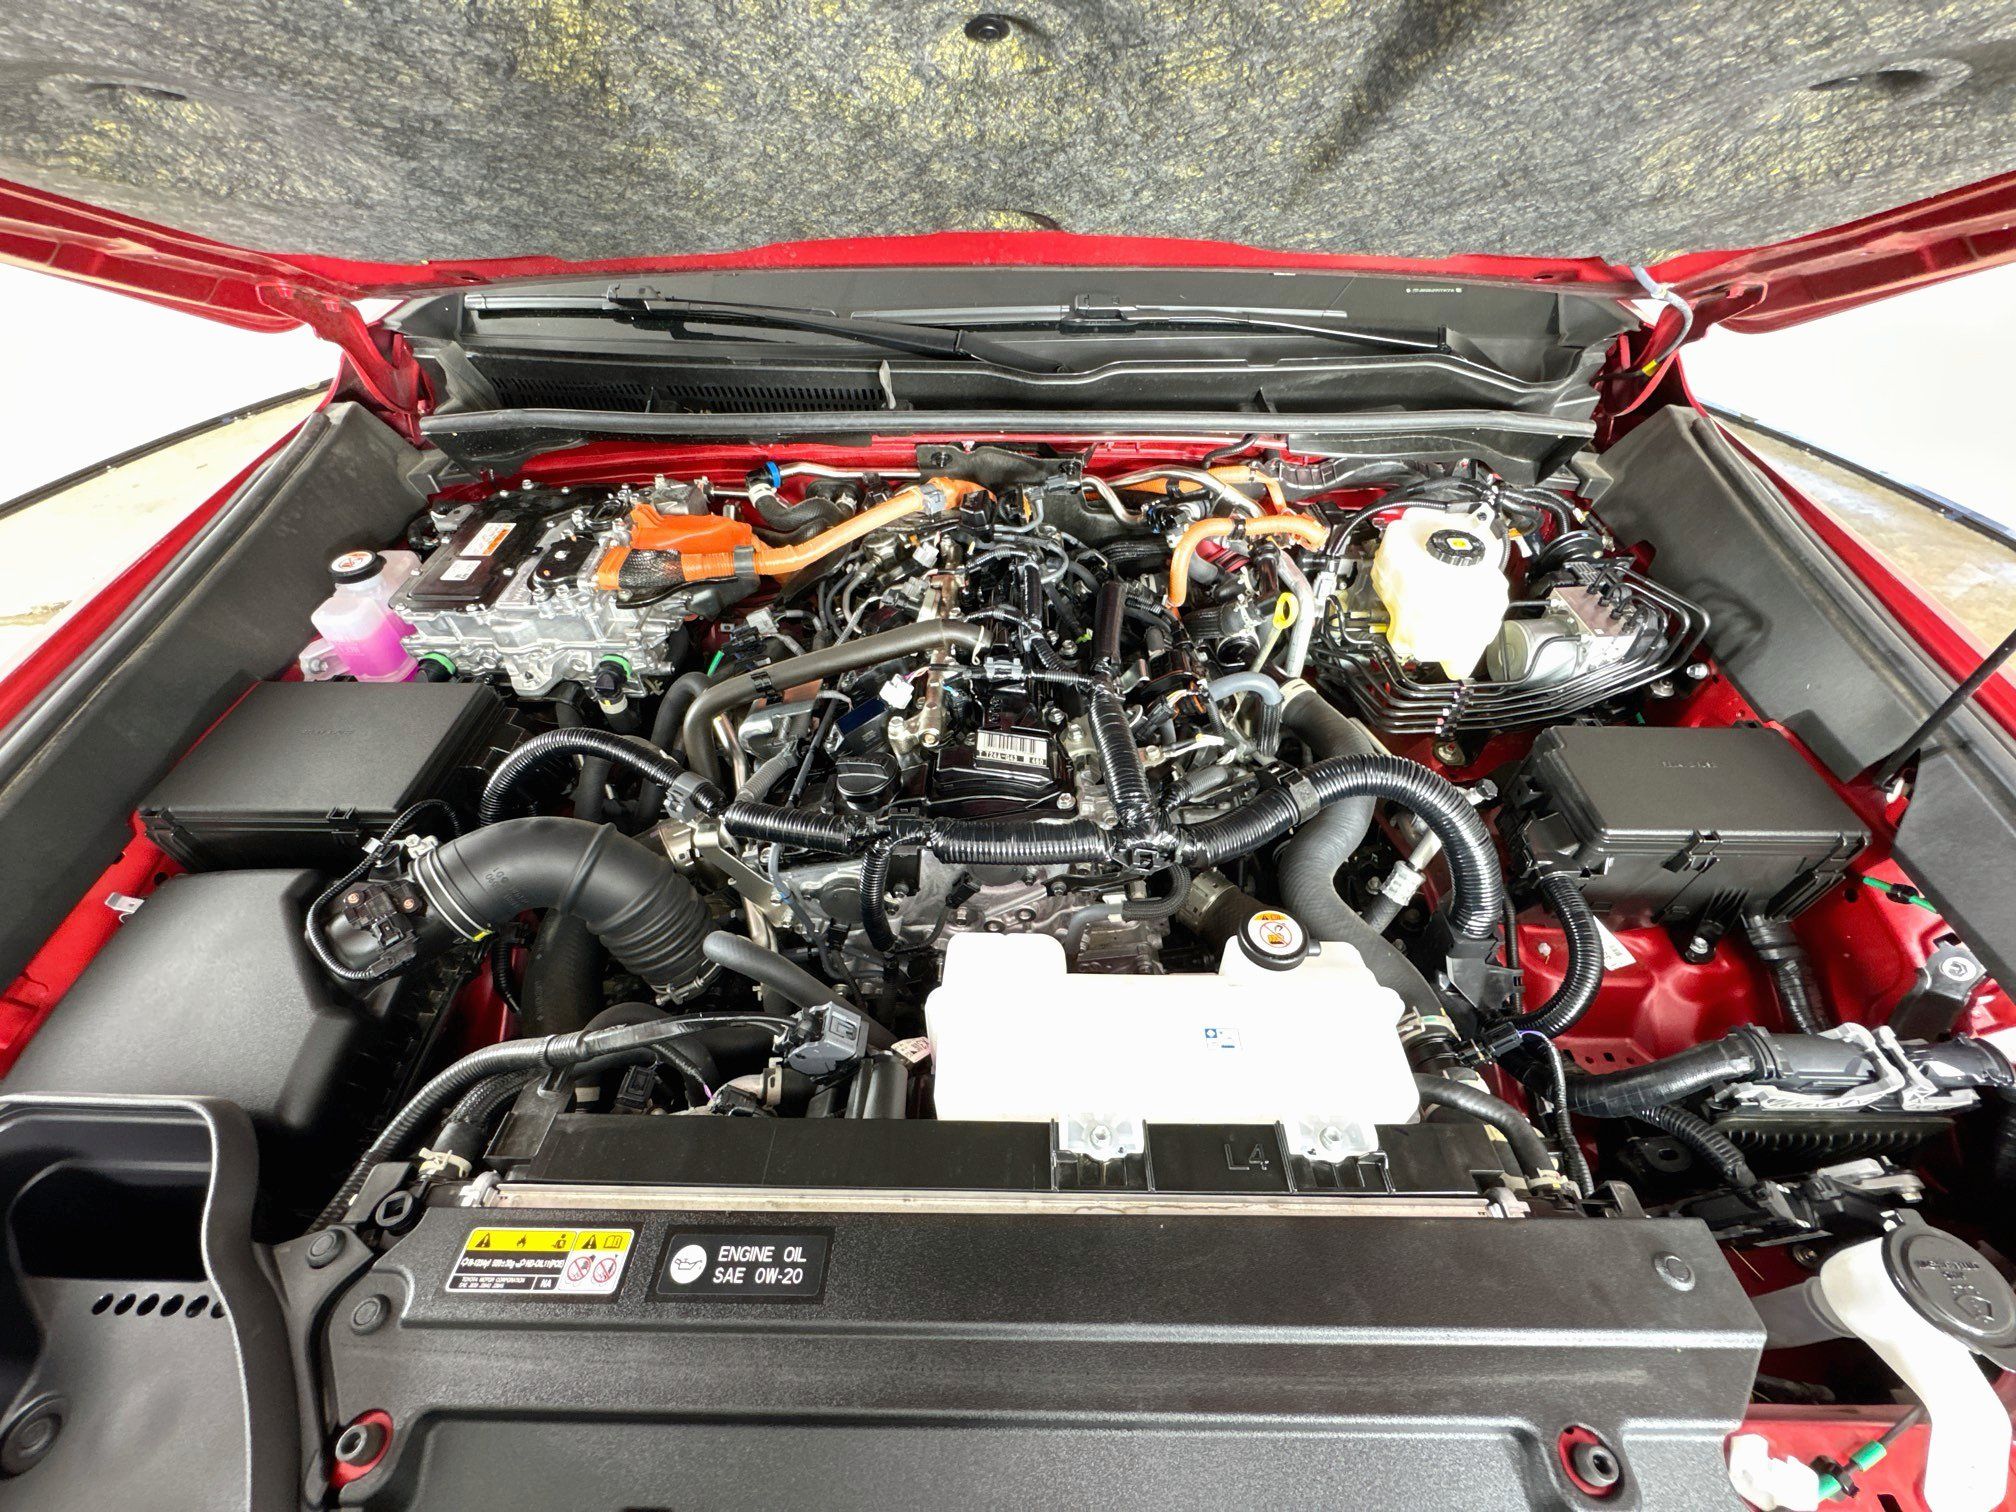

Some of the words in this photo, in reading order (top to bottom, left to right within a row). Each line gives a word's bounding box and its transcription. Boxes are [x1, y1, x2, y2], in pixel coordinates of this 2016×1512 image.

[1224, 1143, 1270, 1171] L4
[717, 1245, 776, 1262] ENGINE
[783, 1246, 807, 1263] OIL
[539, 1278, 552, 1288] NA
[712, 1266, 747, 1284] SAE
[754, 1267, 804, 1285] 0W-20
